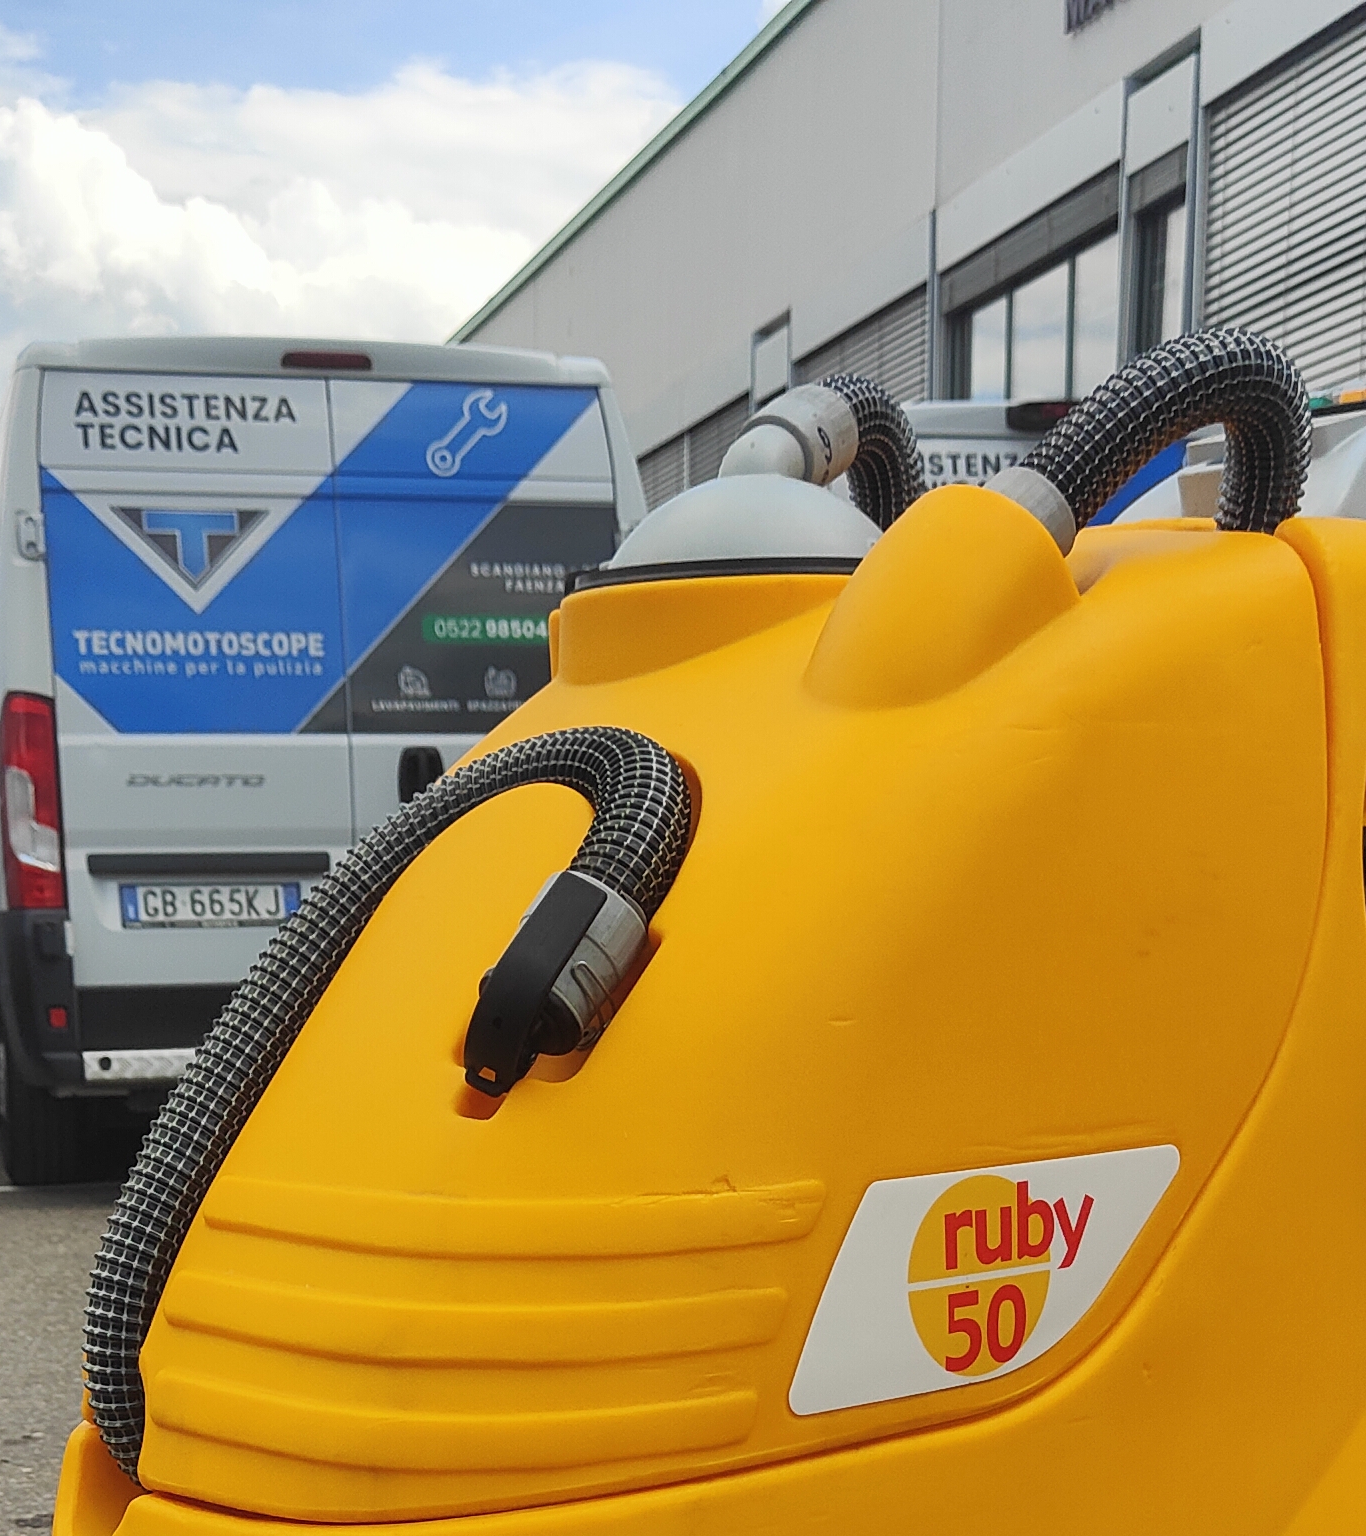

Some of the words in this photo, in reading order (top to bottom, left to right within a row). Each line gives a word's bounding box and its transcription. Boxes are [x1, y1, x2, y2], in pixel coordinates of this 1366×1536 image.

[75, 391, 296, 423] ASSISTENZA
[74, 423, 238, 453] TECNICA
[434, 618, 482, 638] 0522
[73, 629, 325, 658] TECNOMOTOSCOPE
[79, 659, 178, 675] macchine
[185, 661, 218, 678] per
[226, 660, 247, 674] la
[253, 660, 324, 678] pulizia
[126, 773, 266, 787] DUCATO
[143, 889, 177, 918] GB
[190, 888, 280, 917] 665KJ
[944, 1180, 1095, 1270] ruby
[945, 1284, 1027, 1372] 50
